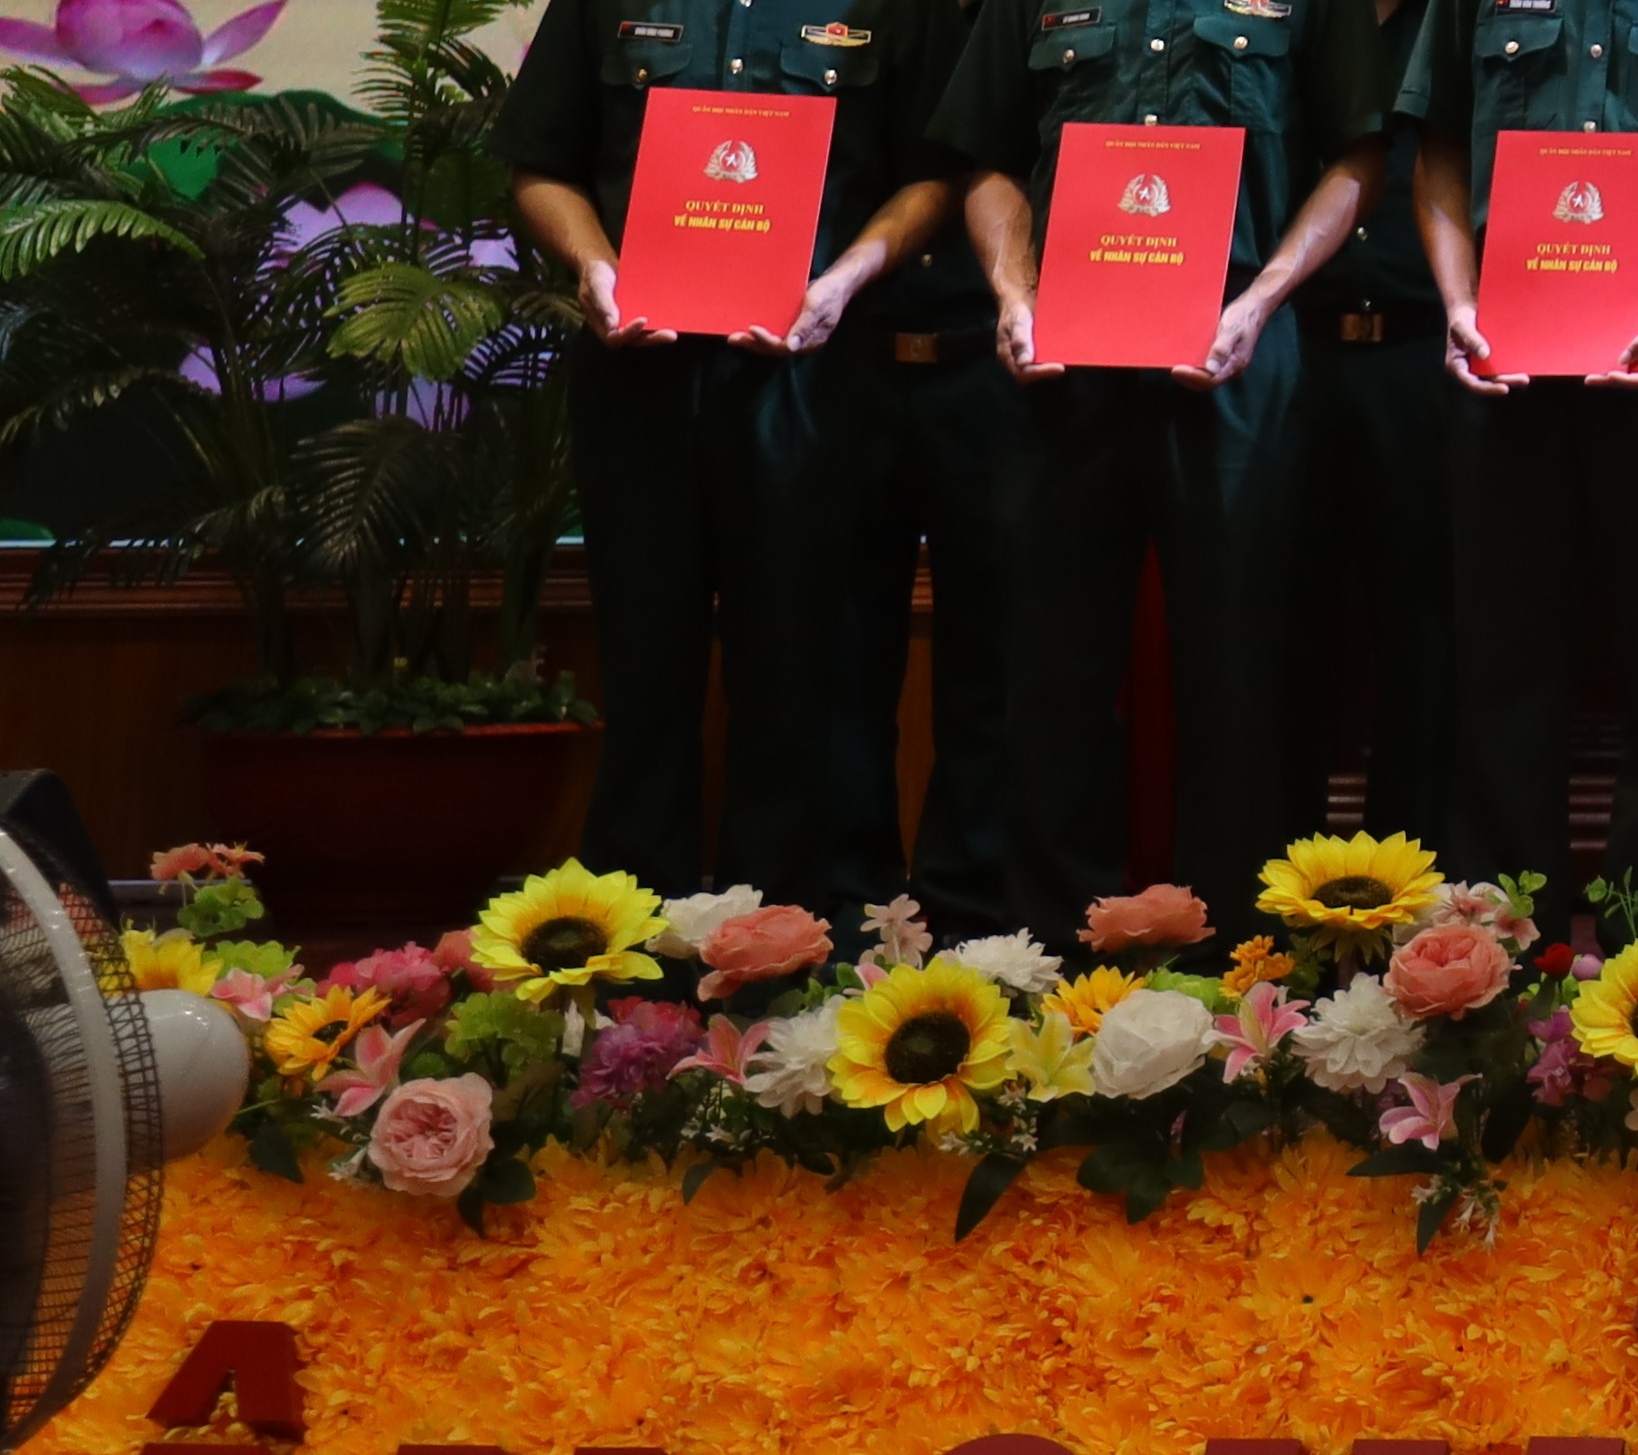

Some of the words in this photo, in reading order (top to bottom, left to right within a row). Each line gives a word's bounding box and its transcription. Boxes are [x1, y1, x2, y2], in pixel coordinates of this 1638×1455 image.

[686, 201, 729, 213] QUYẾT
[732, 204, 764, 215] ĐỊNH
[688, 217, 716, 228] NHÂN
[734, 219, 755, 230] CÁN
[756, 219, 770, 233] BỘ
[1101, 235, 1143, 246] QUYẾT
[1146, 237, 1177, 248] ĐỊNH
[1537, 243, 1578, 254] QUYẾT
[1581, 245, 1610, 256] ĐỊNH
[1104, 251, 1132, 262] NHÂN
[1148, 252, 1169, 263] CÁN
[1170, 252, 1184, 265] BỘ
[1540, 259, 1567, 270] NHÂN
[1583, 260, 1603, 271] CÁN
[1604, 260, 1618, 273] BỘ
